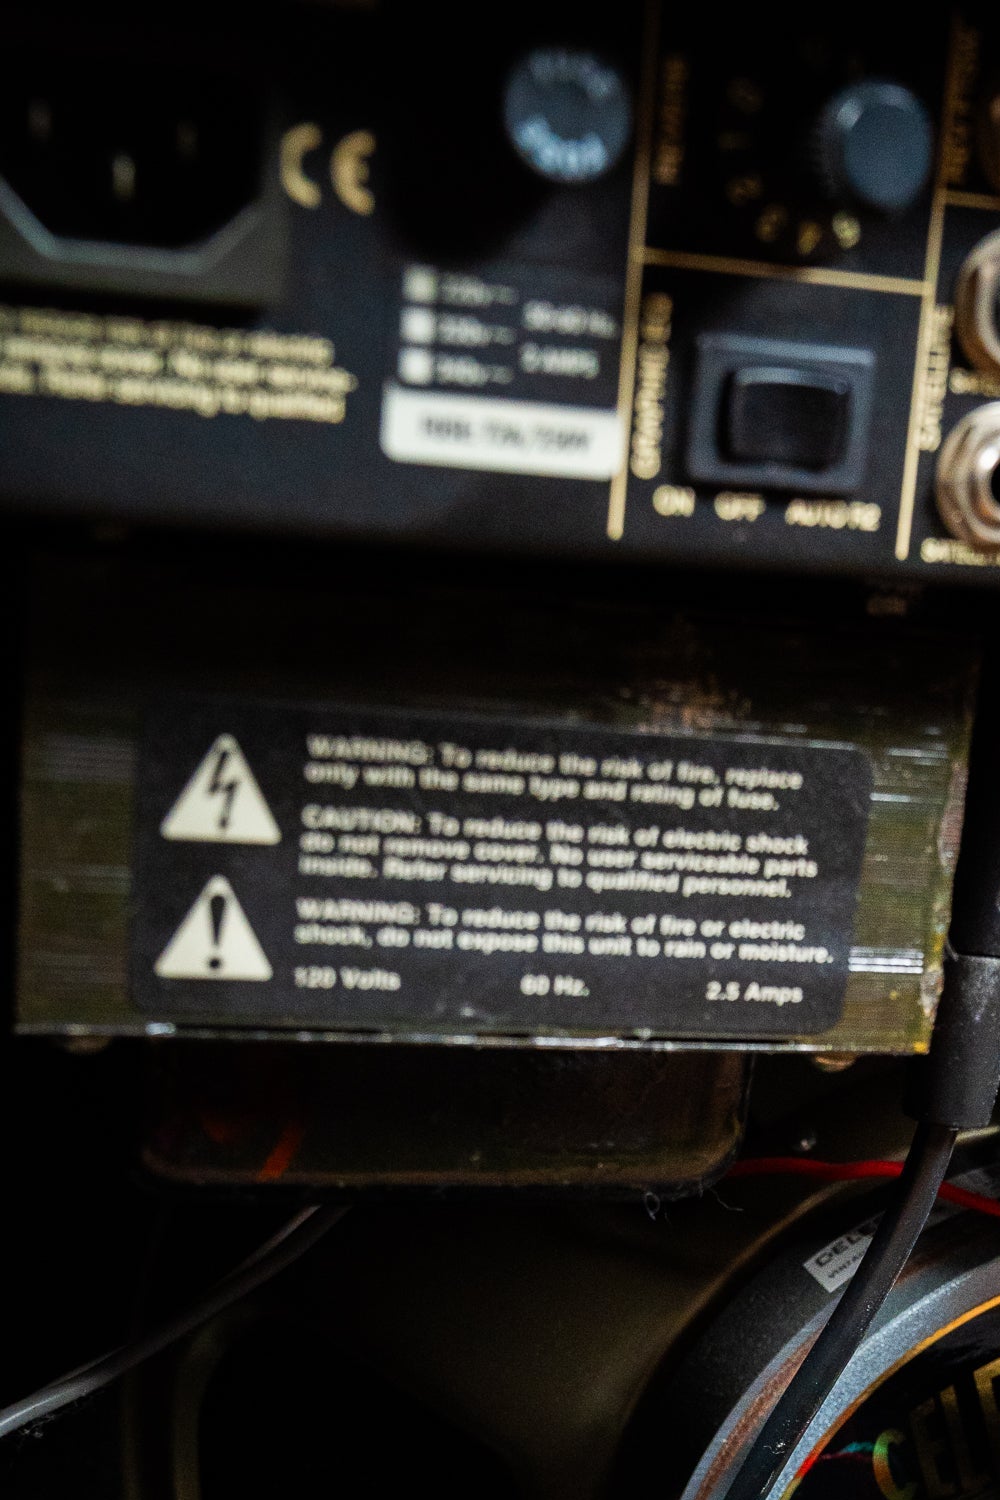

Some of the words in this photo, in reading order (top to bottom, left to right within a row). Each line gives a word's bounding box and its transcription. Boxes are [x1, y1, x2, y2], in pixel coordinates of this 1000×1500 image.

[280, 121, 378, 217] CE
[306, 734, 433, 765] WARNING:
[438, 742, 472, 768] To
[475, 749, 554, 773] reduce
[558, 752, 597, 776] the
[600, 756, 644, 779] risk
[646, 760, 673, 781] of
[676, 761, 719, 786] fire,
[725, 767, 803, 791] replace
[303, 761, 360, 789] only
[362, 765, 416, 789] with
[418, 767, 459, 792] the
[462, 771, 525, 795] same
[529, 777, 580, 802] type
[583, 780, 627, 801] and
[630, 782, 695, 809] rating
[698, 786, 725, 807] of
[727, 788, 779, 810] fuse.
[300, 803, 421, 834] CAUTION:
[427, 811, 460, 837] To
[462, 816, 542, 841] reduce
[545, 820, 584, 843] the
[587, 822, 630, 845] risk
[633, 825, 660, 847] of
[662, 828, 742, 852] electric
[745, 834, 809, 855] shock
[299, 834, 335, 854] do
[337, 834, 380, 856] not
[383, 838, 470, 859] remove
[472, 841, 544, 863] cover.
[549, 843, 583, 866] No
[586, 849, 637, 868] user
[639, 851, 761, 876] serviceable
[763, 858, 819, 879] parts
[382, 857, 448, 882] Refer
[450, 862, 553, 891] servicing
[556, 868, 583, 889] to
[585, 870, 680, 894] qualified
[682, 874, 792, 898] personnel.
[295, 898, 420, 925] WARNING:
[426, 903, 459, 927] To
[461, 906, 540, 931] reduce
[543, 909, 582, 932] the
[584, 912, 628, 934] risk
[630, 914, 657, 935] of
[659, 914, 697, 937] fire
[700, 919, 727, 938] or
[728, 918, 805, 941] electric
[294, 924, 373, 950] shock,
[376, 926, 410, 948] do
[413, 928, 454, 949] not
[456, 930, 539, 955] expose
[542, 932, 586, 955] this
[588, 935, 632, 956] unit
[636, 937, 661, 958] to
[664, 939, 707, 959] rain
[710, 941, 736, 960] or
[738, 942, 834, 964] moisture.
[340, 967, 401, 992] Volts
[520, 974, 551, 997] 60
[705, 980, 740, 1001] 2.5
[743, 982, 803, 1007] Amps
